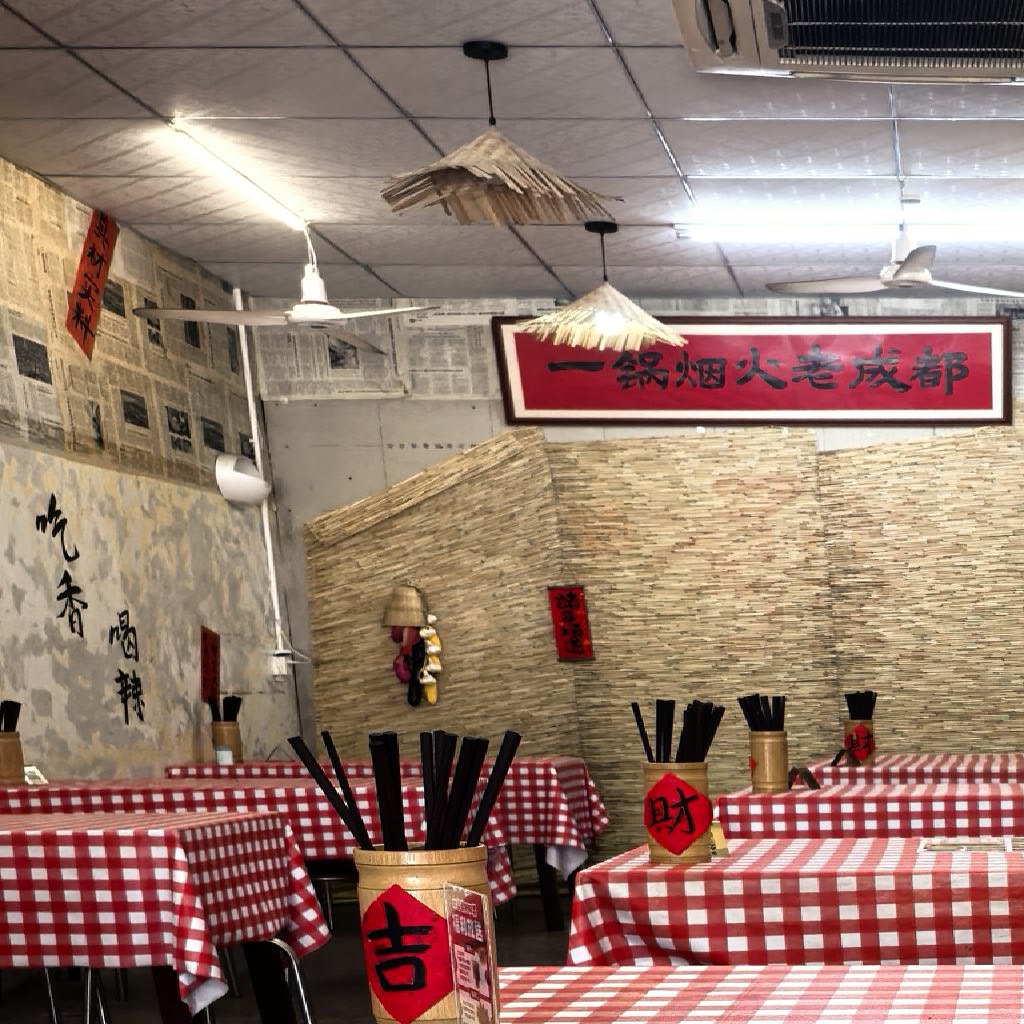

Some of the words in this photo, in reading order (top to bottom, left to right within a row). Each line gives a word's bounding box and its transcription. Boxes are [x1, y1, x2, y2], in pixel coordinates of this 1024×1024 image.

[547, 344, 970, 395] 一锅烟火老成都
[36, 493, 88, 637] 吃香
[367, 900, 434, 992] 吉
